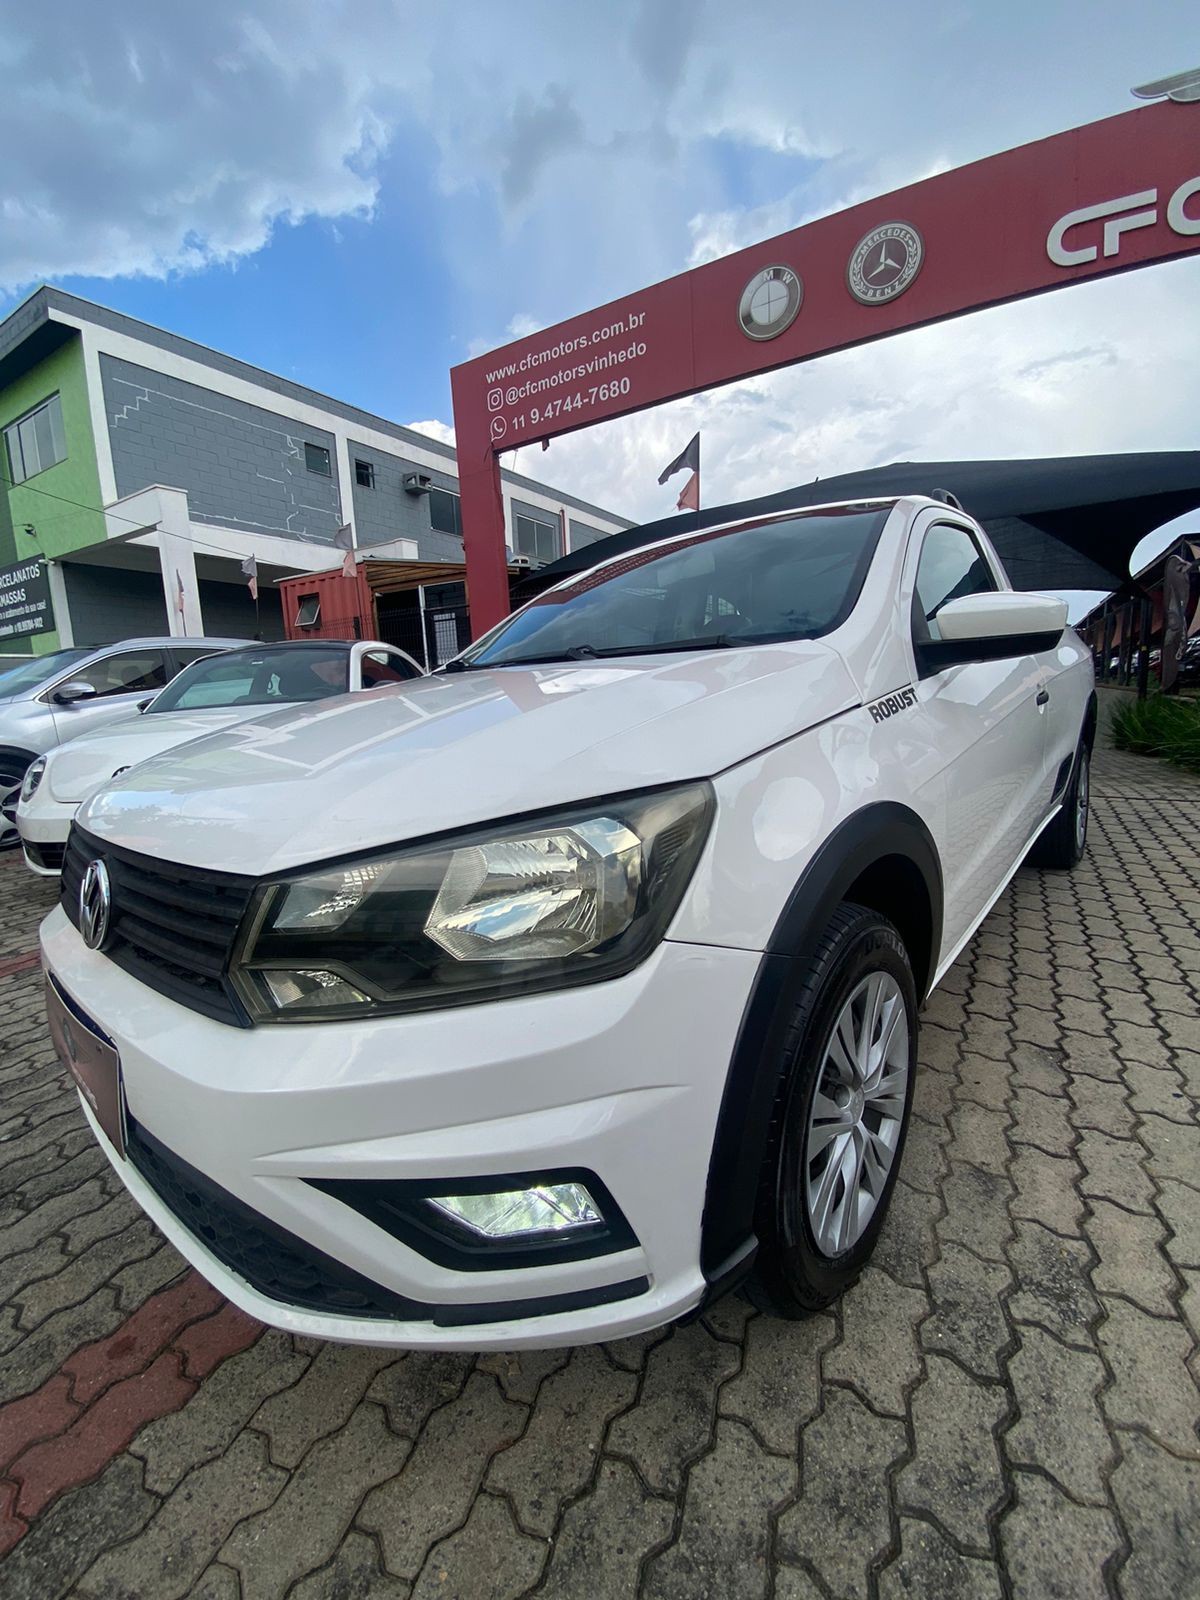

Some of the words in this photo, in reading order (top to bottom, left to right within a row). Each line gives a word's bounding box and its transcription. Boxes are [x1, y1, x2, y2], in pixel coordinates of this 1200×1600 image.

[861, 228, 911, 255] MERCEDES
[867, 281, 900, 298] BENZ
[485, 311, 646, 385] www.cfcmotors.com.br
[505, 342, 647, 406] @cfcmotorsvinhedo
[512, 414, 526, 431] 11
[530, 376, 631, 425] 9.4744-7680
[868, 687, 919, 724] ROBUST
